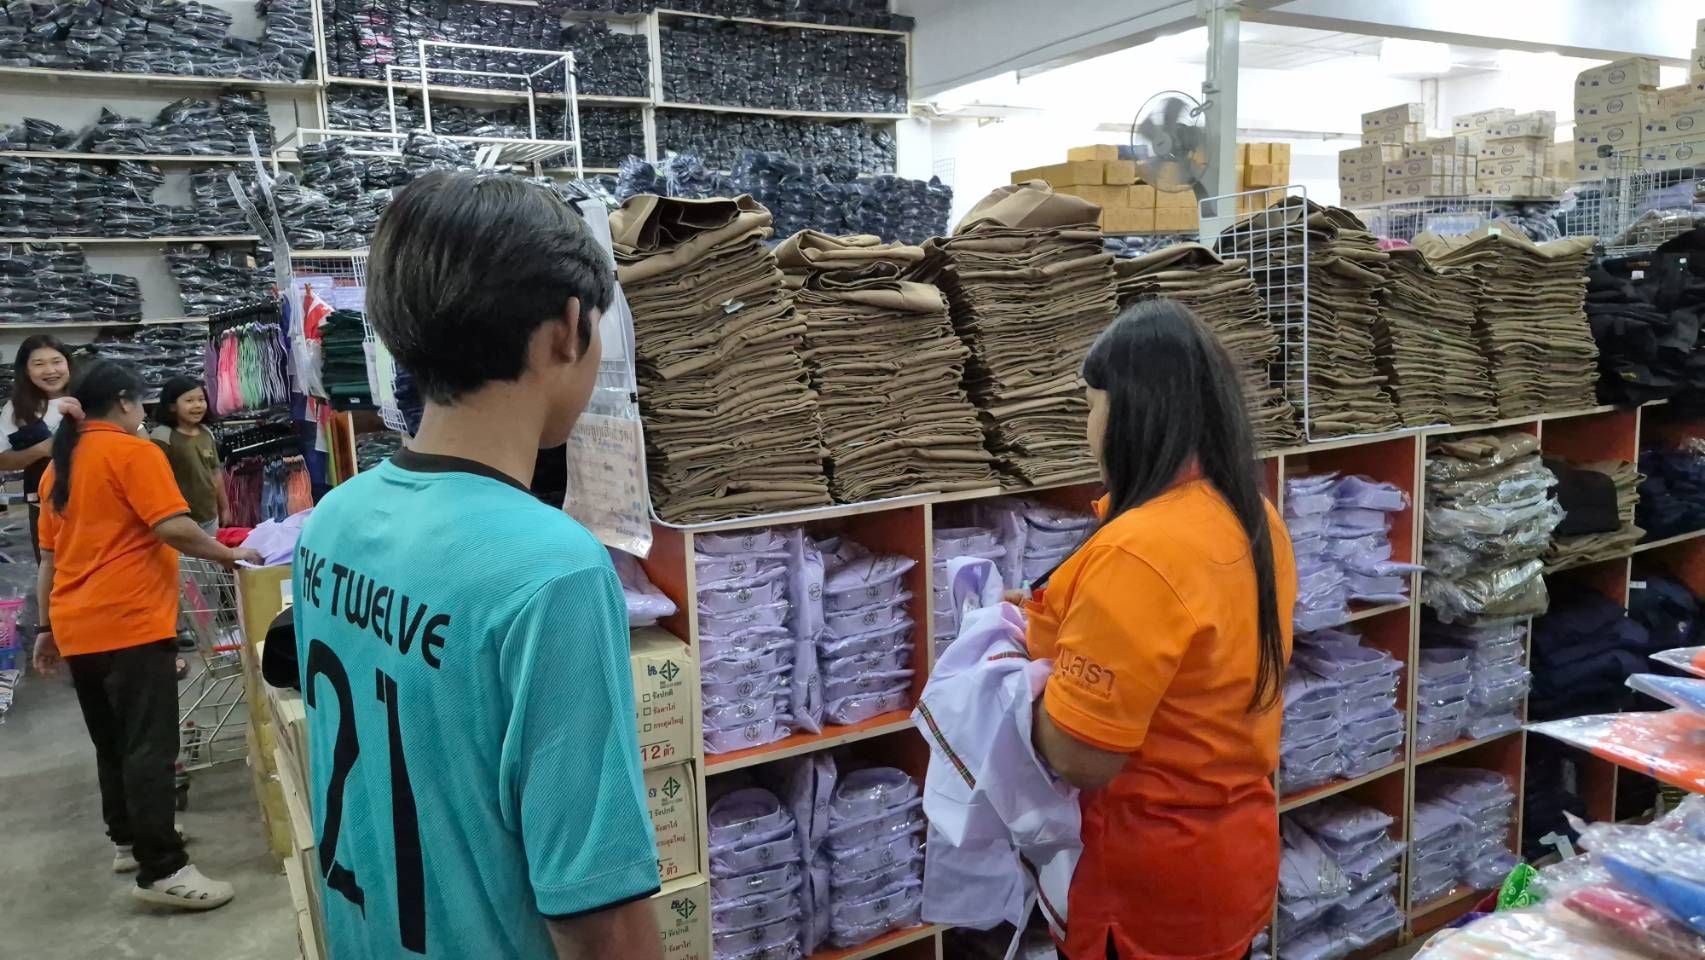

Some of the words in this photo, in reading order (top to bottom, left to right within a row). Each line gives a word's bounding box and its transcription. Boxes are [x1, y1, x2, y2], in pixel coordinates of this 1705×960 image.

[331, 562, 451, 669] TWELVE
[306, 638, 427, 955] 21
[640, 744, 661, 762] 12
[663, 743, 675, 757] ตัว
